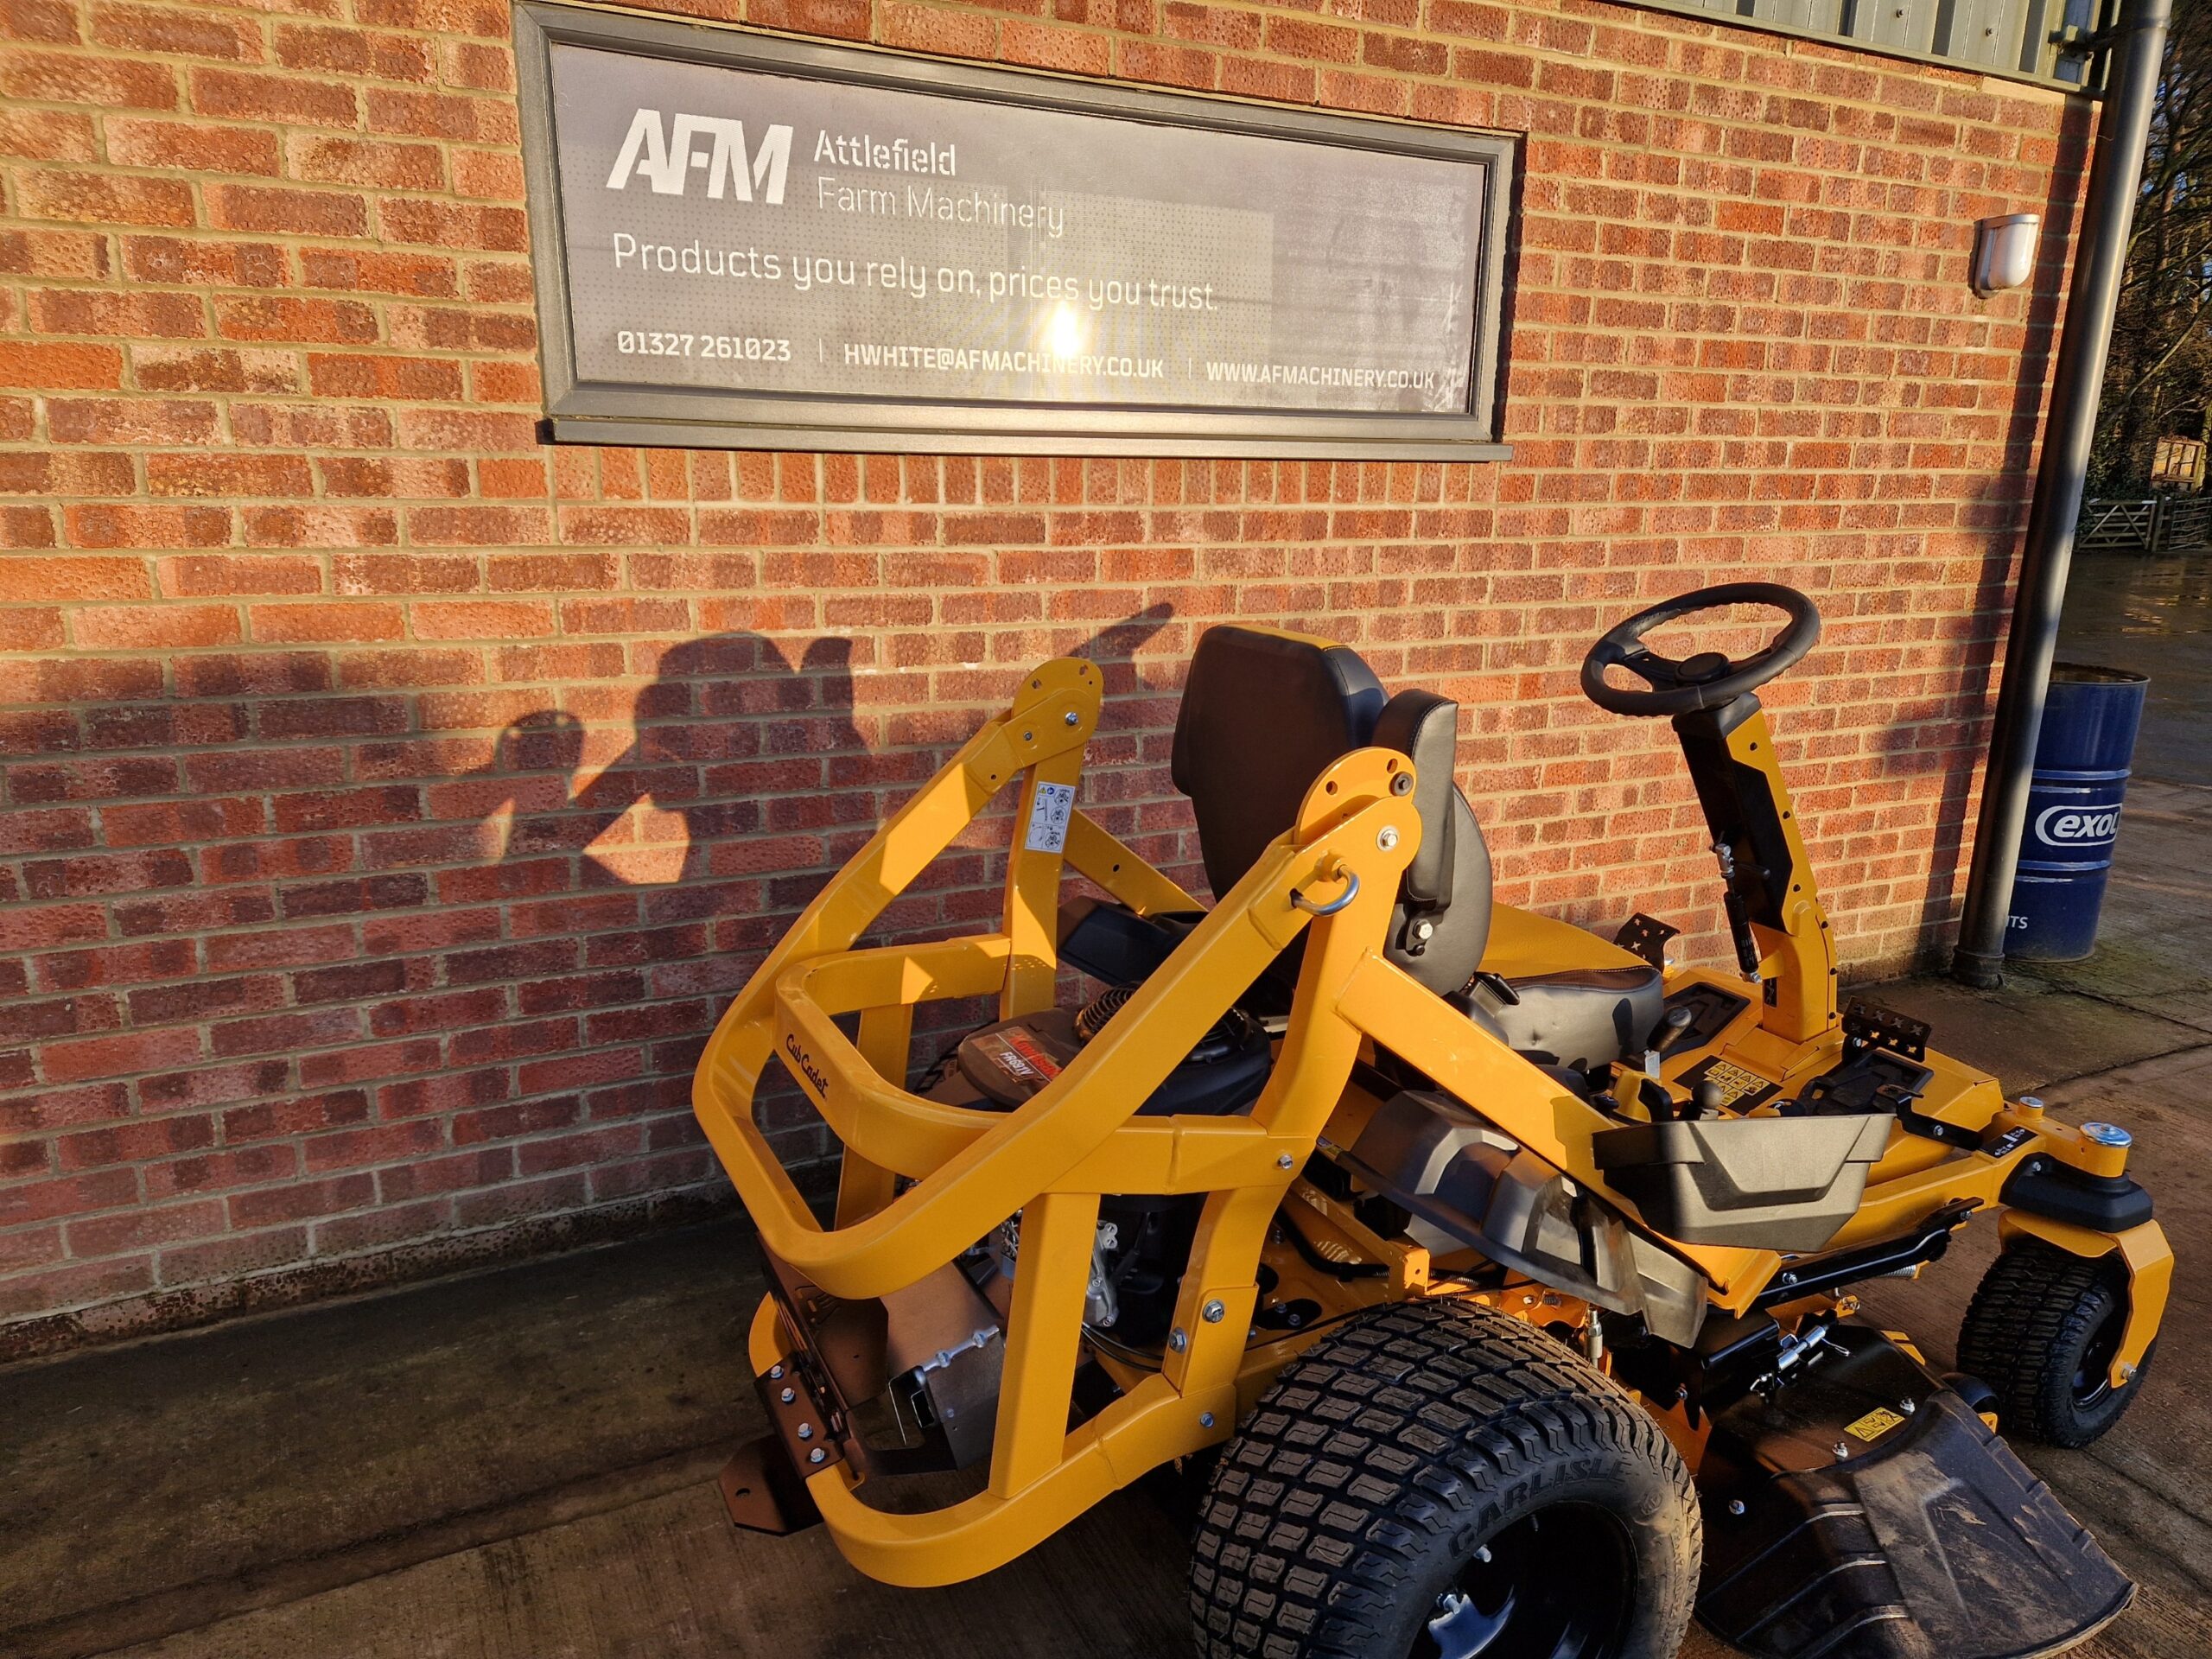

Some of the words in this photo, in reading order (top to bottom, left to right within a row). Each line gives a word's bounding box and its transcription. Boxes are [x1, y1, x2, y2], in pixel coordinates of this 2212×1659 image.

[606, 108, 793, 205] AFM
[814, 129, 956, 175] Attlefield
[817, 176, 896, 215] Farm
[907, 185, 1064, 238] Machinery
[613, 232, 782, 279] Products
[792, 256, 855, 291] you
[867, 256, 927, 299] rely
[937, 267, 982, 298] on,
[988, 265, 1080, 303] prices
[1088, 278, 1141, 312] you
[1148, 278, 1218, 311] trust.
[617, 330, 694, 357] 01327
[700, 335, 791, 362] 261023
[843, 343, 1164, 378] HWHITE@AFMACHINERY.CO.UK
[1206, 361, 1435, 390] WWW.AFMACHINERY.CO.UK
[786, 1033, 802, 1064] Cub
[801, 1053, 829, 1099] Cadet
[999, 1051, 1035, 1076] FR691V
[1448, 1458, 1633, 1560] CARLISLE
